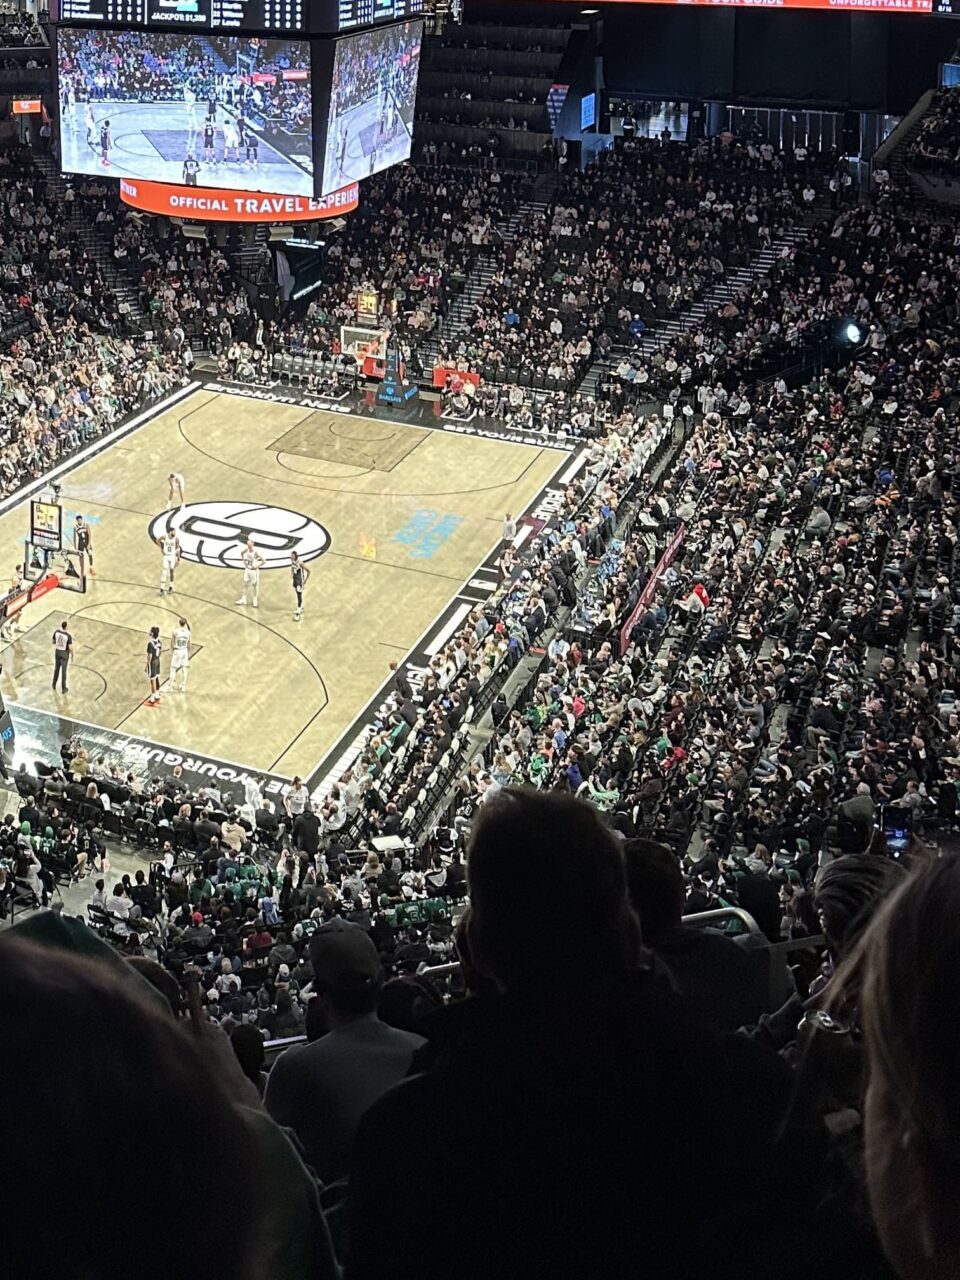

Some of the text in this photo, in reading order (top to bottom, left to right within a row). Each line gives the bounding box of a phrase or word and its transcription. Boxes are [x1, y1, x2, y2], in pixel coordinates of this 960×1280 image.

[152, 12, 184, 22] JACKPOT:
[170, 195, 228, 211] OFFICIAL
[234, 198, 304, 214] TRAVEL
[202, 382, 352, 414] Brooklyn Nets
[378, 393, 402, 403] BARCLAYS
